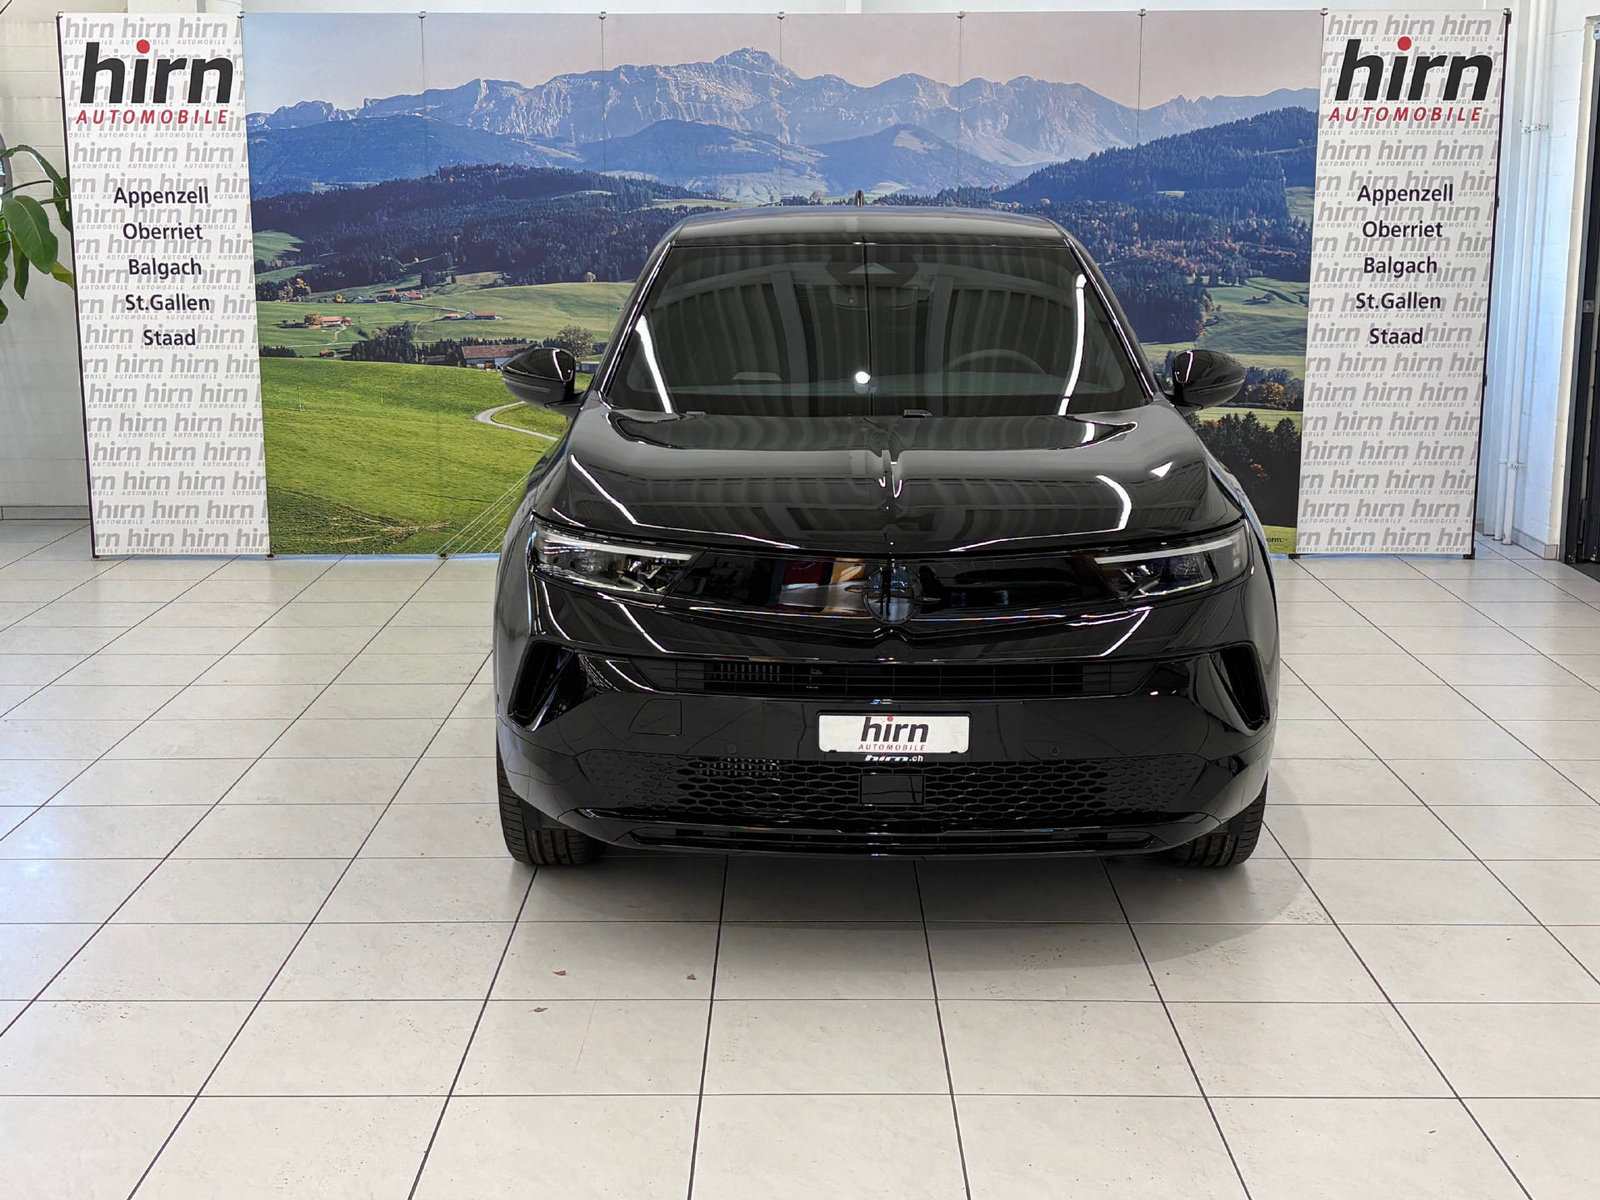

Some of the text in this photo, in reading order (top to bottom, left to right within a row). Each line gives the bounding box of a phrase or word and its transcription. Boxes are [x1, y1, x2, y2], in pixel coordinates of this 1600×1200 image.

[65, 17, 228, 38] hirn hirn hirn
[1327, 14, 1492, 35] hirn hirn hirn
[80, 39, 233, 104] hirn
[1334, 36, 1493, 101] hirn
[76, 110, 228, 124] AUTOMOBILE
[1328, 107, 1483, 121] AUTOMOBILE
[73, 142, 234, 162] hirn hirn hirn
[1321, 139, 1484, 160] hirn hirn hirn
[113, 186, 208, 208] Appenzell
[1357, 184, 1453, 206] Appenzell
[77, 203, 237, 223] hirn hirn hirn
[1318, 201, 1480, 221] hirn hirn hirn
[123, 222, 203, 240] Oberriet
[1362, 220, 1443, 238] Oberriet
[81, 264, 130, 284] hirn
[129, 258, 202, 279] Balgach
[1315, 262, 1364, 282] hirn
[1364, 256, 1437, 278] Balgach
[126, 294, 210, 311] St.Gallen
[1356, 292, 1441, 309] St.Gallen
[85, 324, 244, 343] hirn hirn
[143, 329, 196, 346] Staad
[1311, 322, 1472, 342] hirn hirn
[1369, 327, 1423, 344] Staad
[115, 353, 218, 373] hirn hirn
[1337, 352, 1443, 372] hirn hirn
[89, 383, 248, 402] hirn hirn hirn
[1308, 382, 1469, 401] hirn hirn hirn
[119, 413, 222, 432] hirn hirn
[1334, 411, 1439, 430] hirn hirn
[93, 442, 251, 461] hirn hirn hirn
[1304, 441, 1465, 460] hirn hirn hirn
[122, 471, 225, 490] hirn hirn
[1330, 470, 1435, 489] hirn hirn
[97, 500, 254, 518] hirn hirn hirn
[1301, 499, 1460, 517] hirn hirn hirn
[126, 529, 229, 547] hirn hirn
[1327, 527, 1431, 546] hirn hirn
[861, 716, 929, 742] hirn
